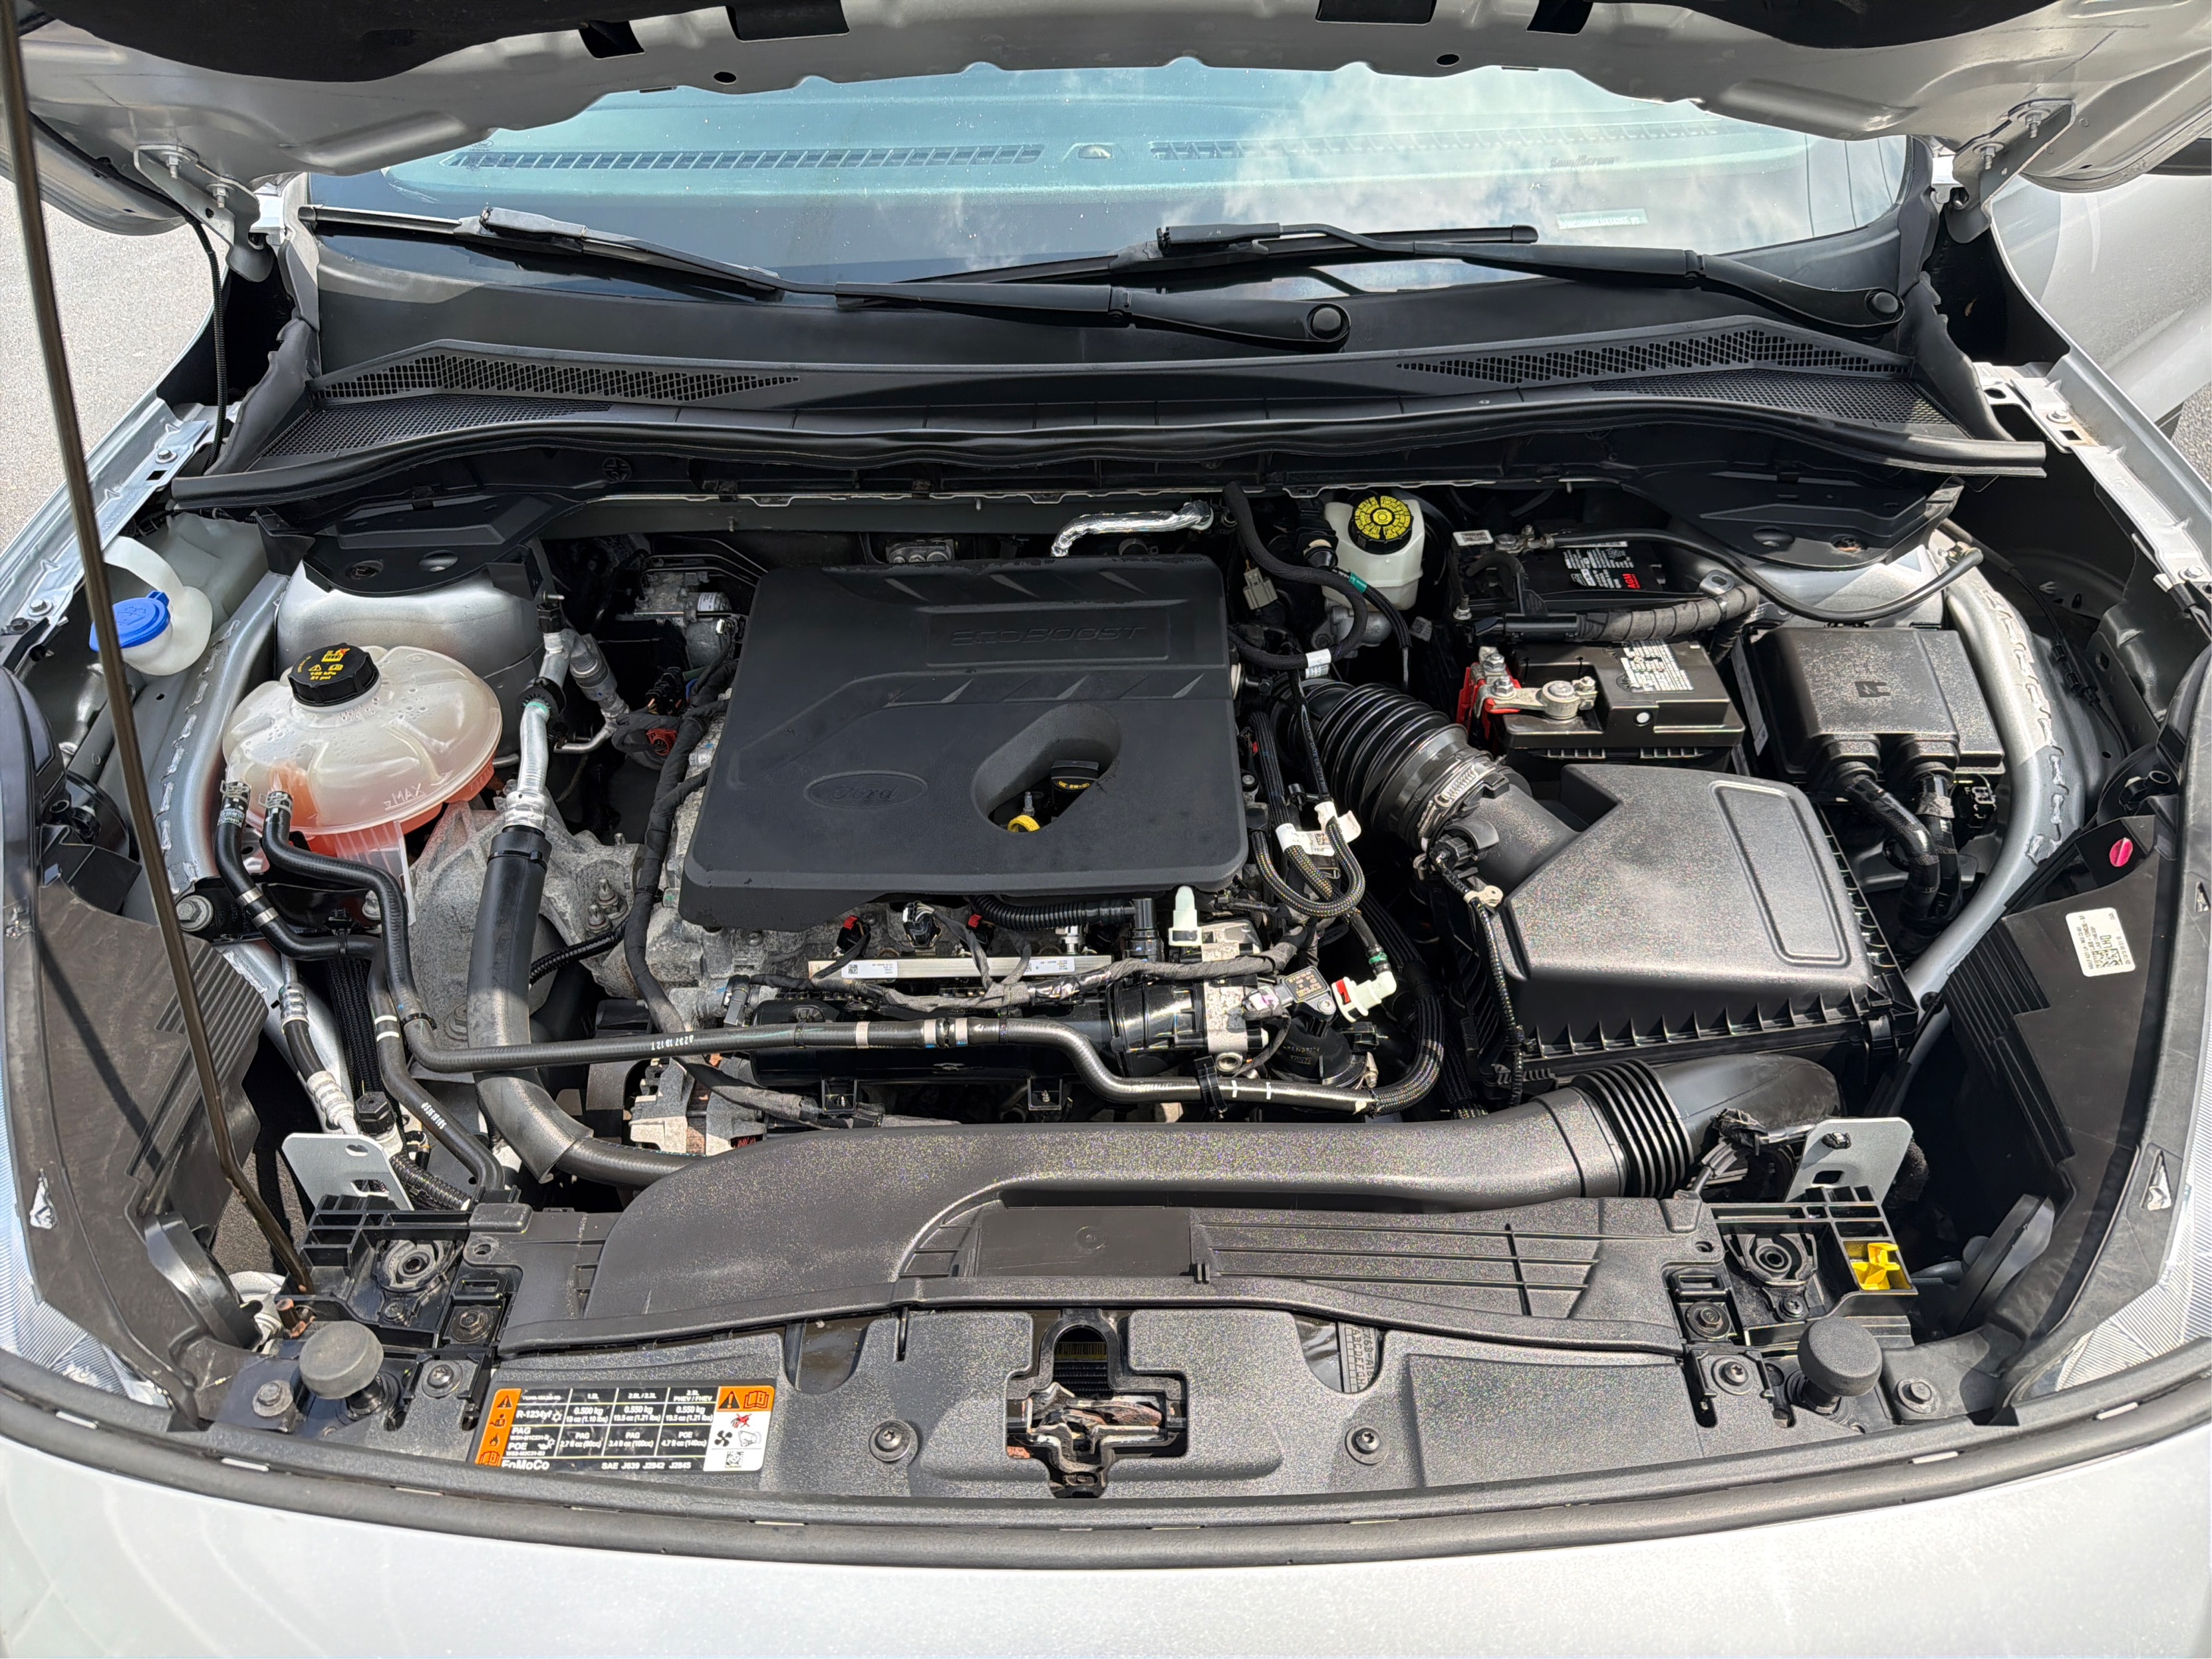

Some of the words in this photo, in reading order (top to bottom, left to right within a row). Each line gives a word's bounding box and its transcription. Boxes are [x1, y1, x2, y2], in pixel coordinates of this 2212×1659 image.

[1623, 573, 1637, 588] AGM
[391, 783, 427, 805] MAX
[831, 782, 898, 801] Ford
[515, 1410, 553, 1420] R-1234yf
[593, 1407, 604, 1416] kg
[643, 1406, 654, 1415] kg
[696, 1406, 706, 1414] kg
[501, 1460, 550, 1470] FoMoCo
